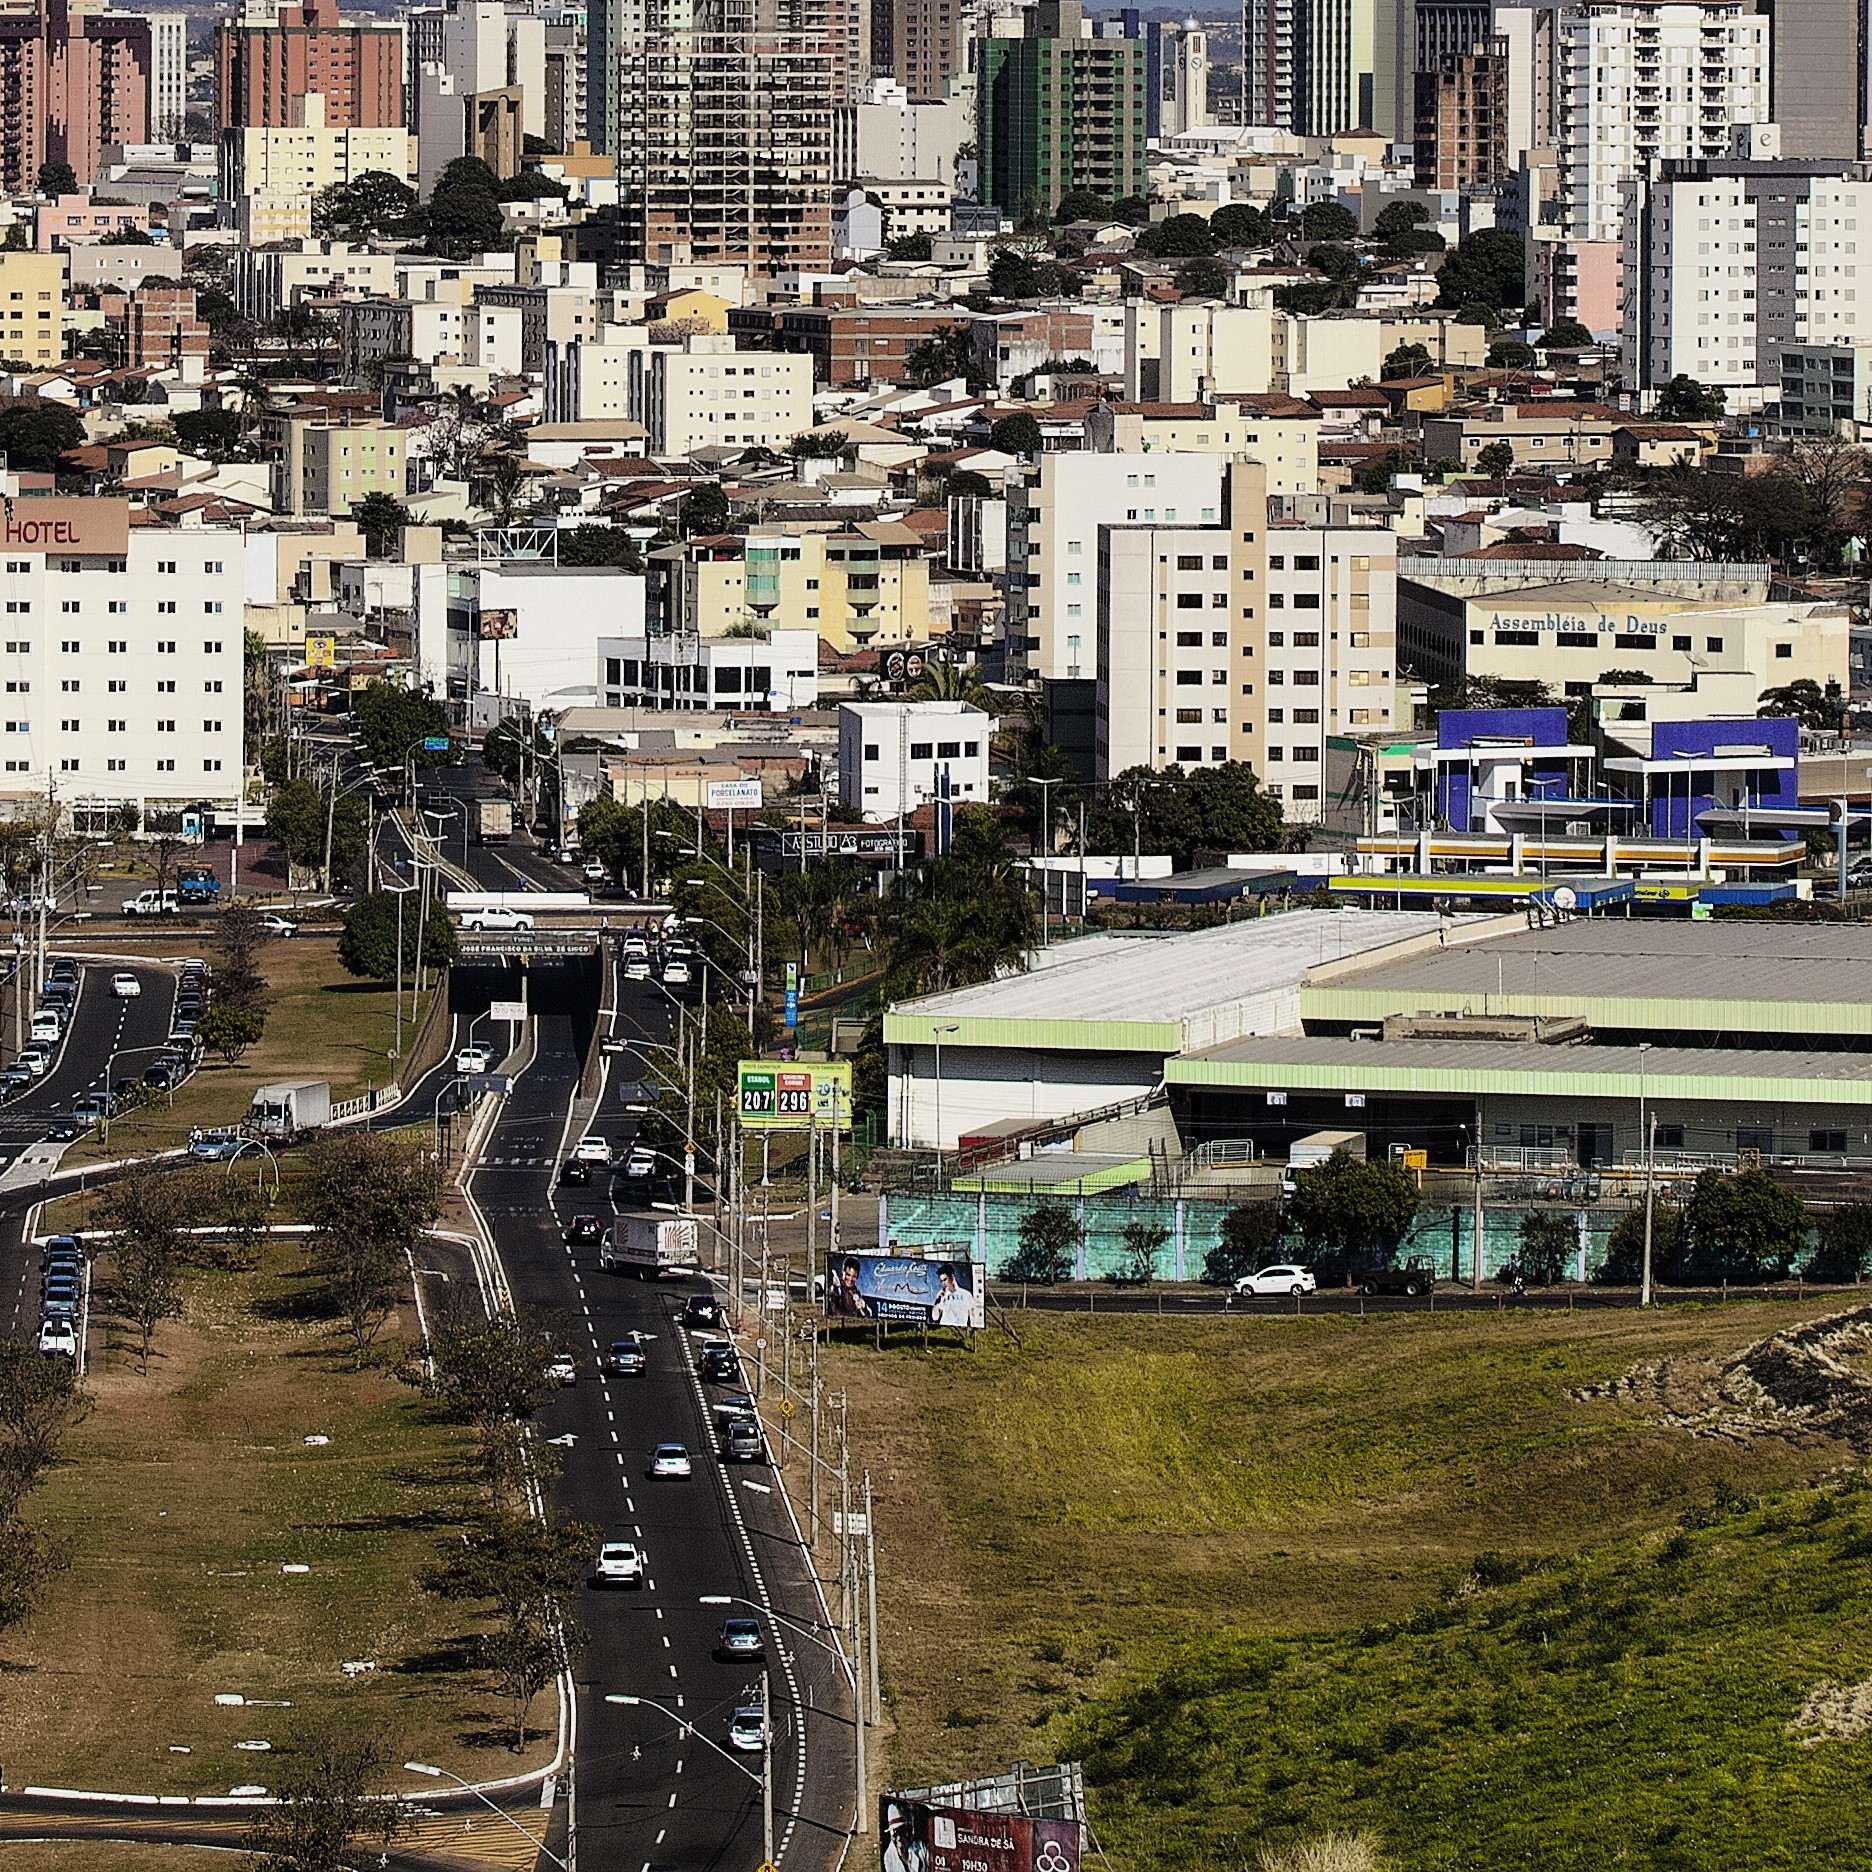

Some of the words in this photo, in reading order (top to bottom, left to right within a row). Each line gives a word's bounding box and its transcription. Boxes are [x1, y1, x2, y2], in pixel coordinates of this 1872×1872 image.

[6, 521, 80, 543] HOTEL
[1489, 613, 1586, 632] Assembléia
[1598, 614, 1615, 633] de
[1626, 614, 1668, 634] Deus
[711, 788, 758, 797] PORCELANATO
[957, 1833, 989, 1847] SANDRA
